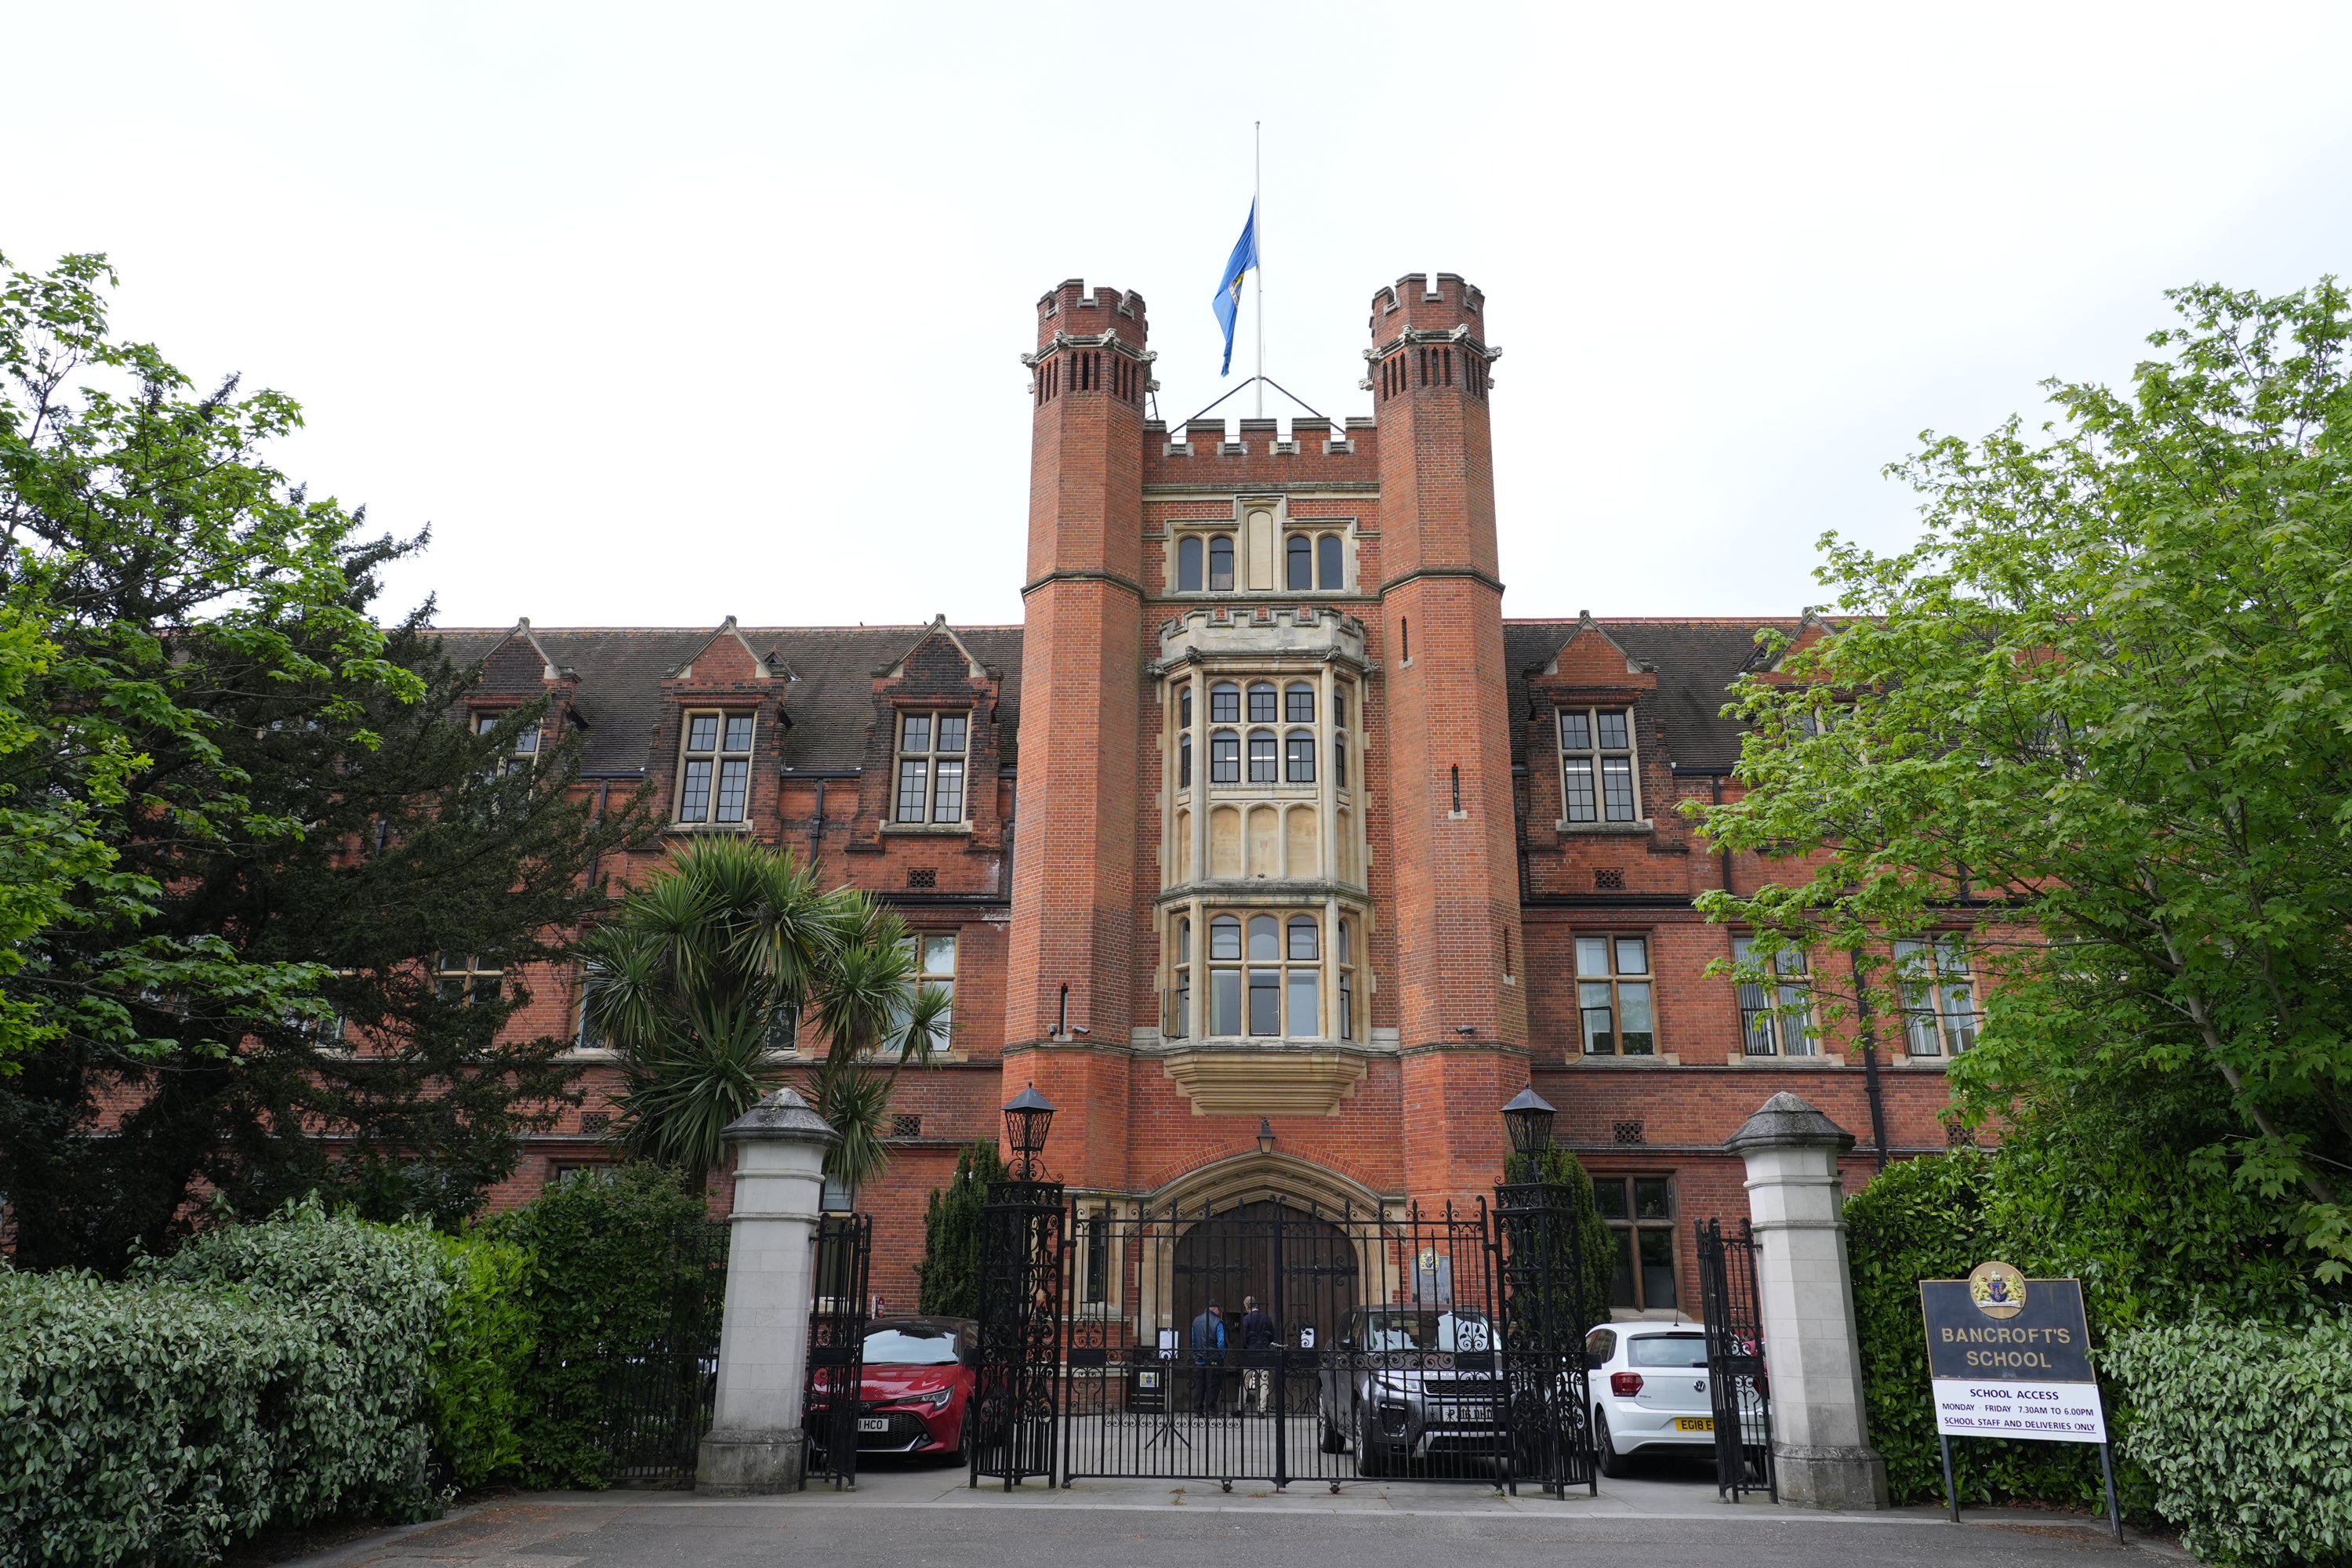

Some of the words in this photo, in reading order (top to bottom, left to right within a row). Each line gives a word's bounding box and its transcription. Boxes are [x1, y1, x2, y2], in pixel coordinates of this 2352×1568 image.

[1941, 1327, 2071, 1344] BANCROFT'S
[1966, 1351, 2052, 1368] SCHOOL
[1970, 1388, 2012, 1399] SCHOOL
[2017, 1390, 2059, 1400] ACCESS
[2018, 1406, 2048, 1414] 7.30AM
[864, 1420, 883, 1429] HCO
[1681, 1420, 1704, 1430] EG18
[1706, 1421, 1715, 1430] E
[2025, 1421, 2071, 1430] DELIVERIES
[2074, 1423, 2095, 1432] ONLY
